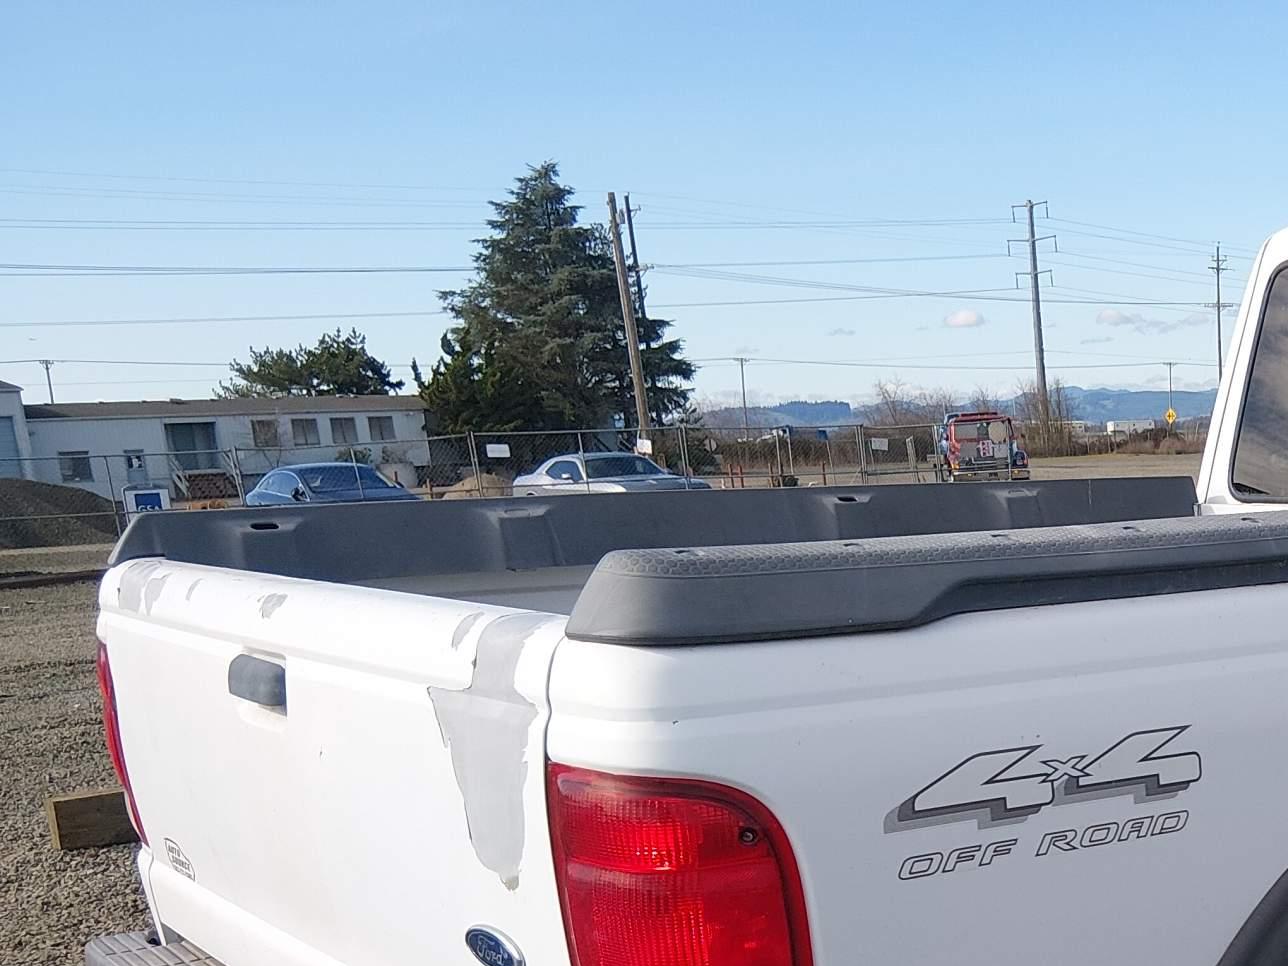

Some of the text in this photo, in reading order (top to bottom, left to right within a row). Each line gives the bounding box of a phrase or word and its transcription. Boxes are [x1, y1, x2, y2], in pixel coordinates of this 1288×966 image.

[898, 810, 1189, 881] OFF ROAD
[477, 934, 507, 966] Ford
